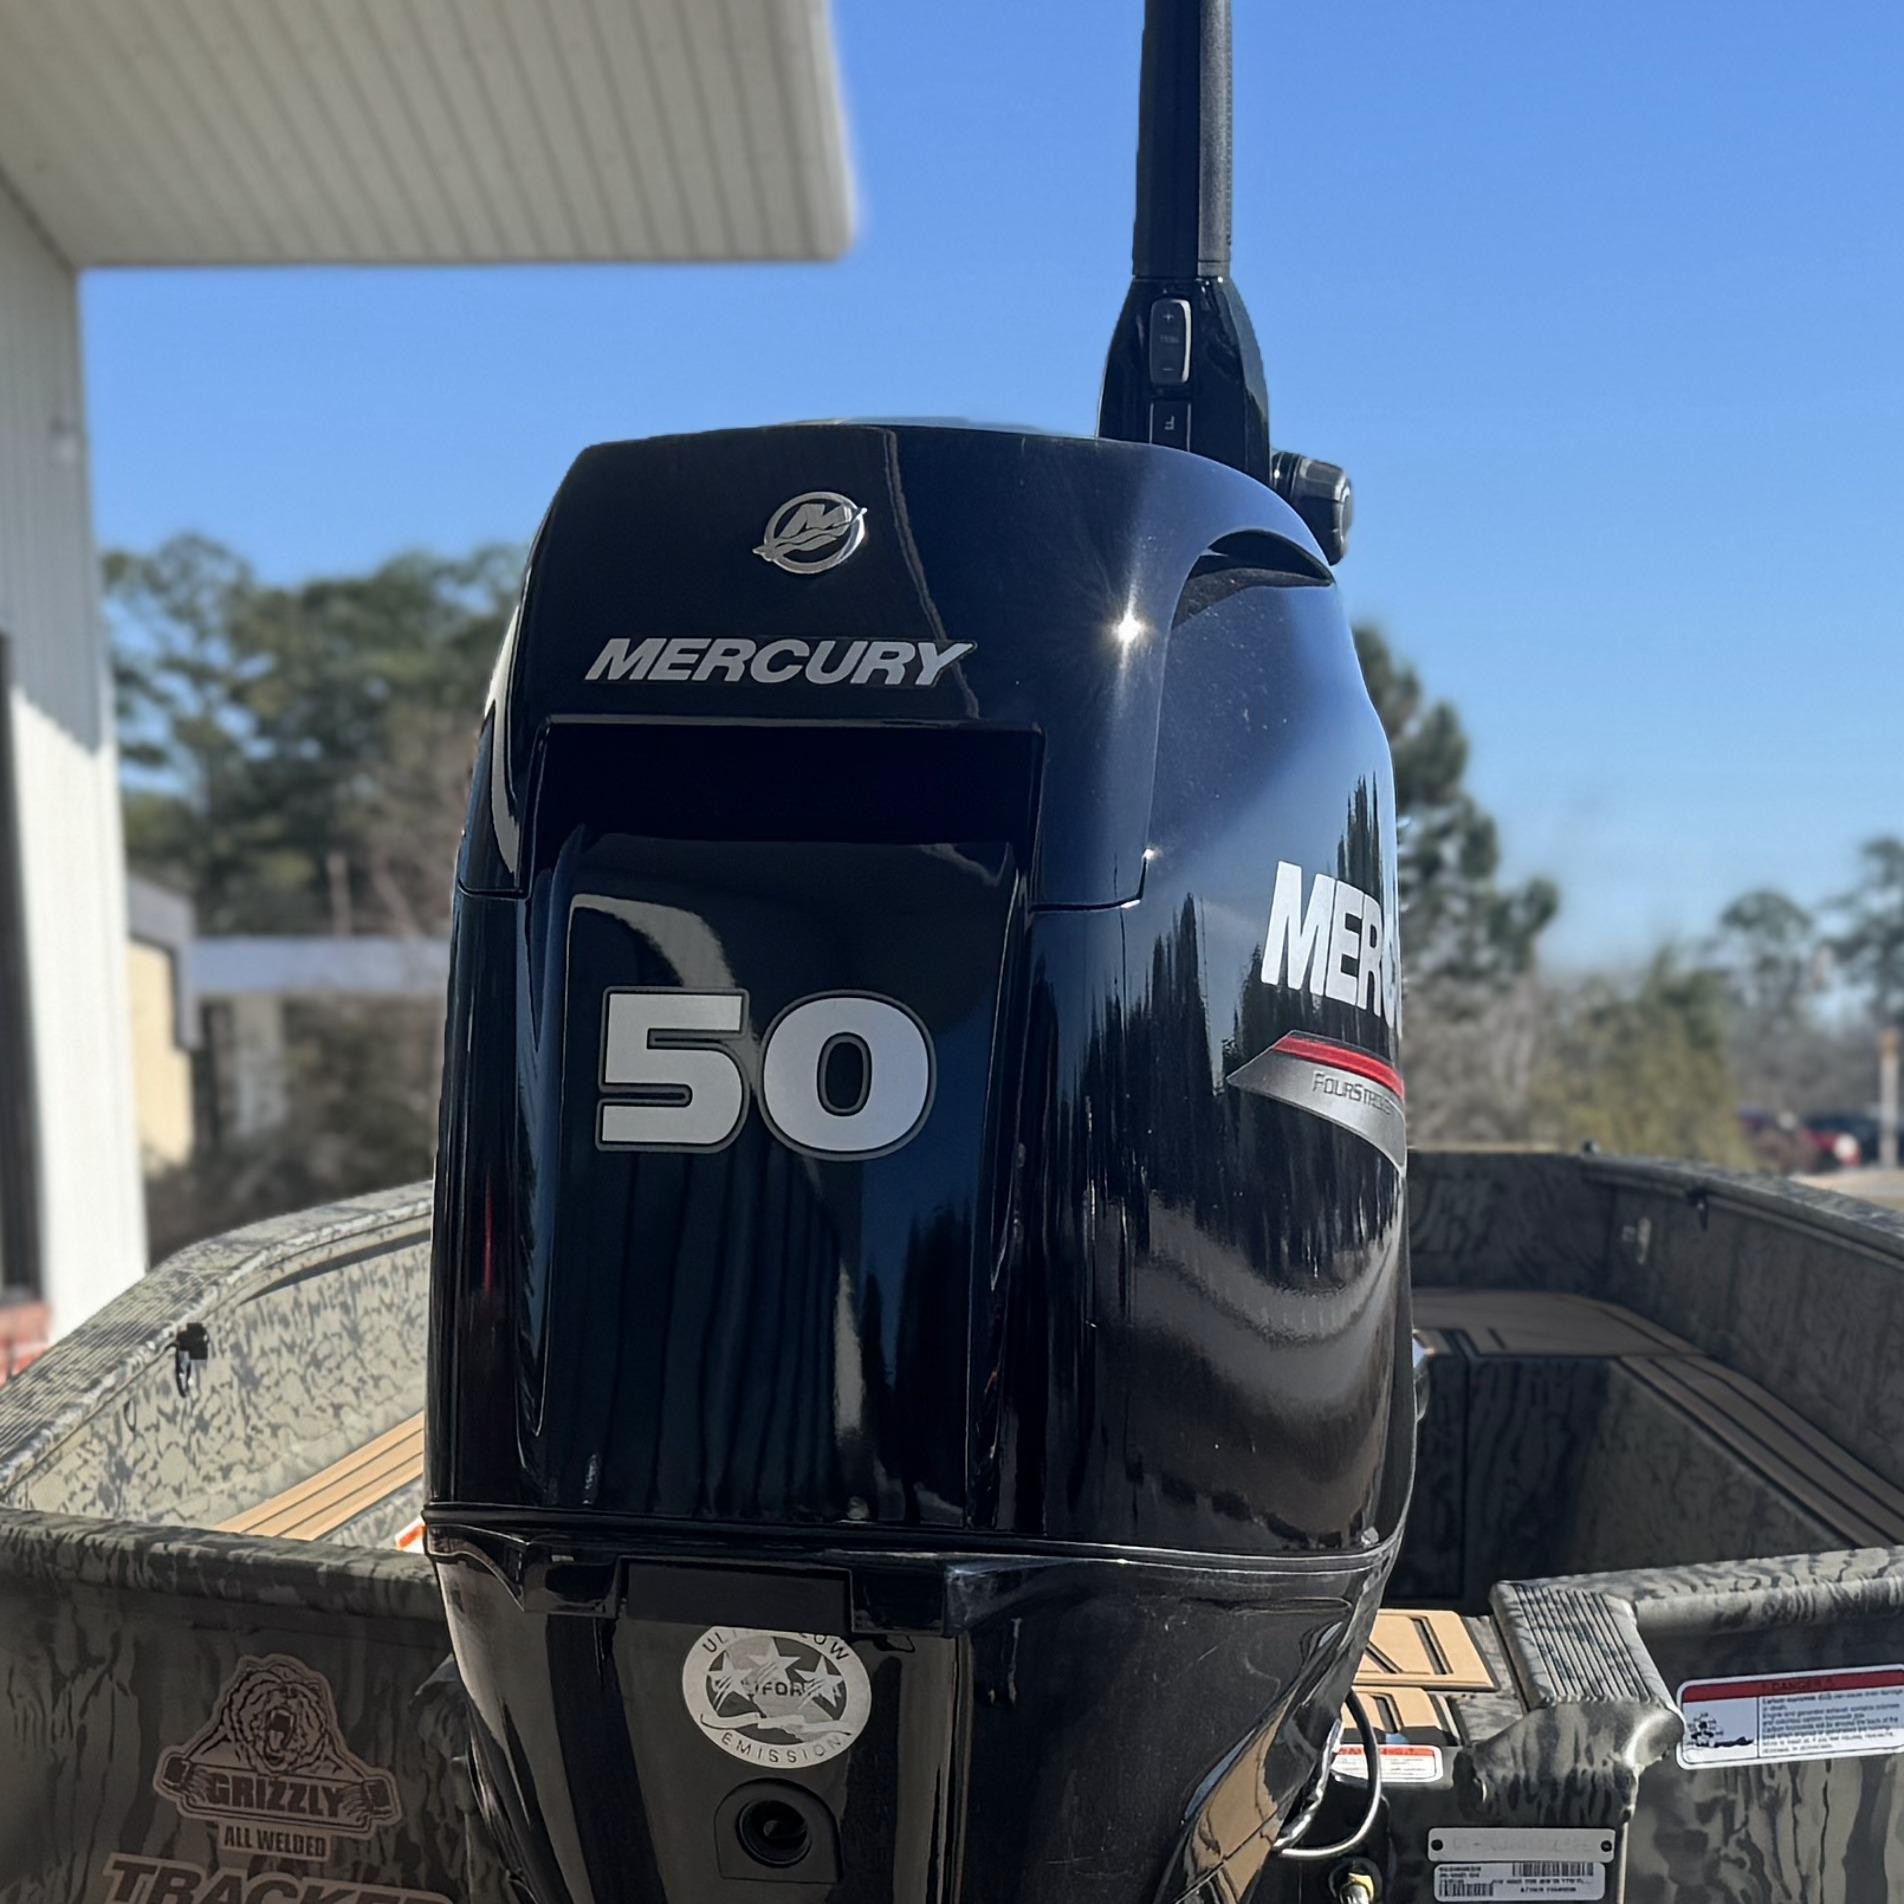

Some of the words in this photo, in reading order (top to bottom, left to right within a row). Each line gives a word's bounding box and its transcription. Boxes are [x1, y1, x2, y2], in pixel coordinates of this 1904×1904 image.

[584, 637, 978, 687] MERCURY
[597, 987, 935, 1160] 50
[208, 1773, 342, 1818] GRIZZLY
[224, 1826, 253, 1848] ALL
[257, 1829, 326, 1857] WELDED
